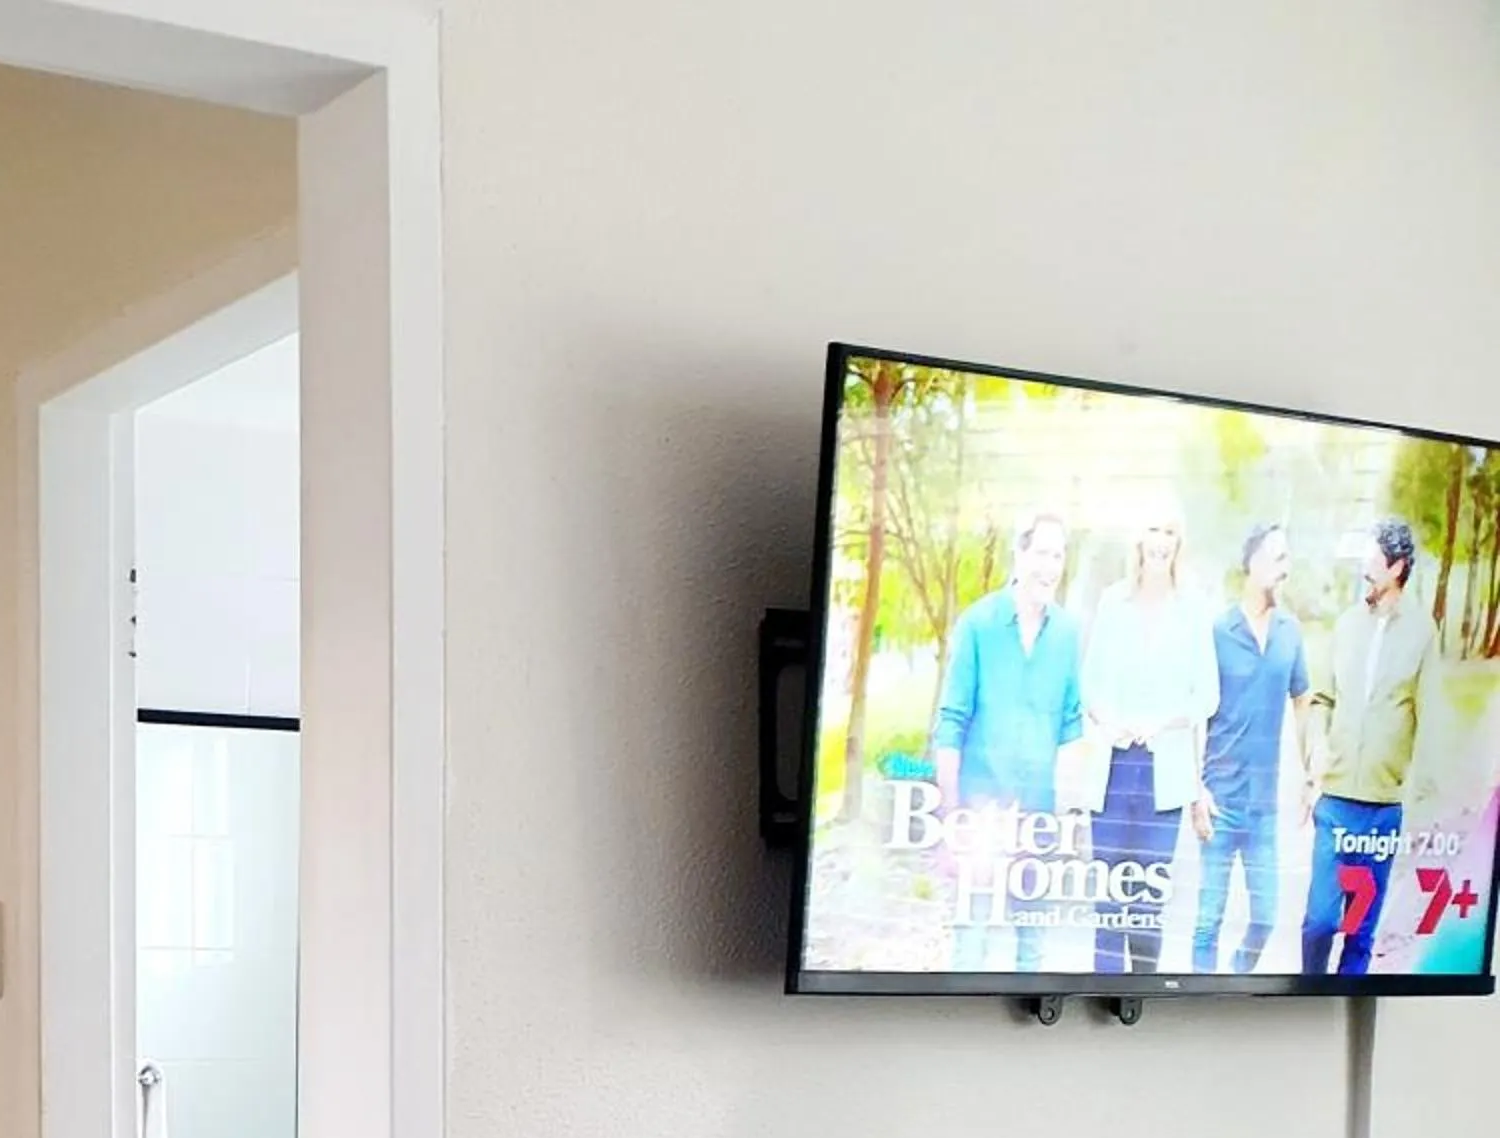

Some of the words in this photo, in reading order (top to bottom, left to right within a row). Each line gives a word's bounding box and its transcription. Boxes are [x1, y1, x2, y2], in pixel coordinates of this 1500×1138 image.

[880, 779, 1090, 856] Better
[1332, 827, 1413, 862] Tonight
[952, 853, 1174, 928] Homes
[1012, 905, 1061, 927] and
[1065, 904, 1170, 929] Gardens
